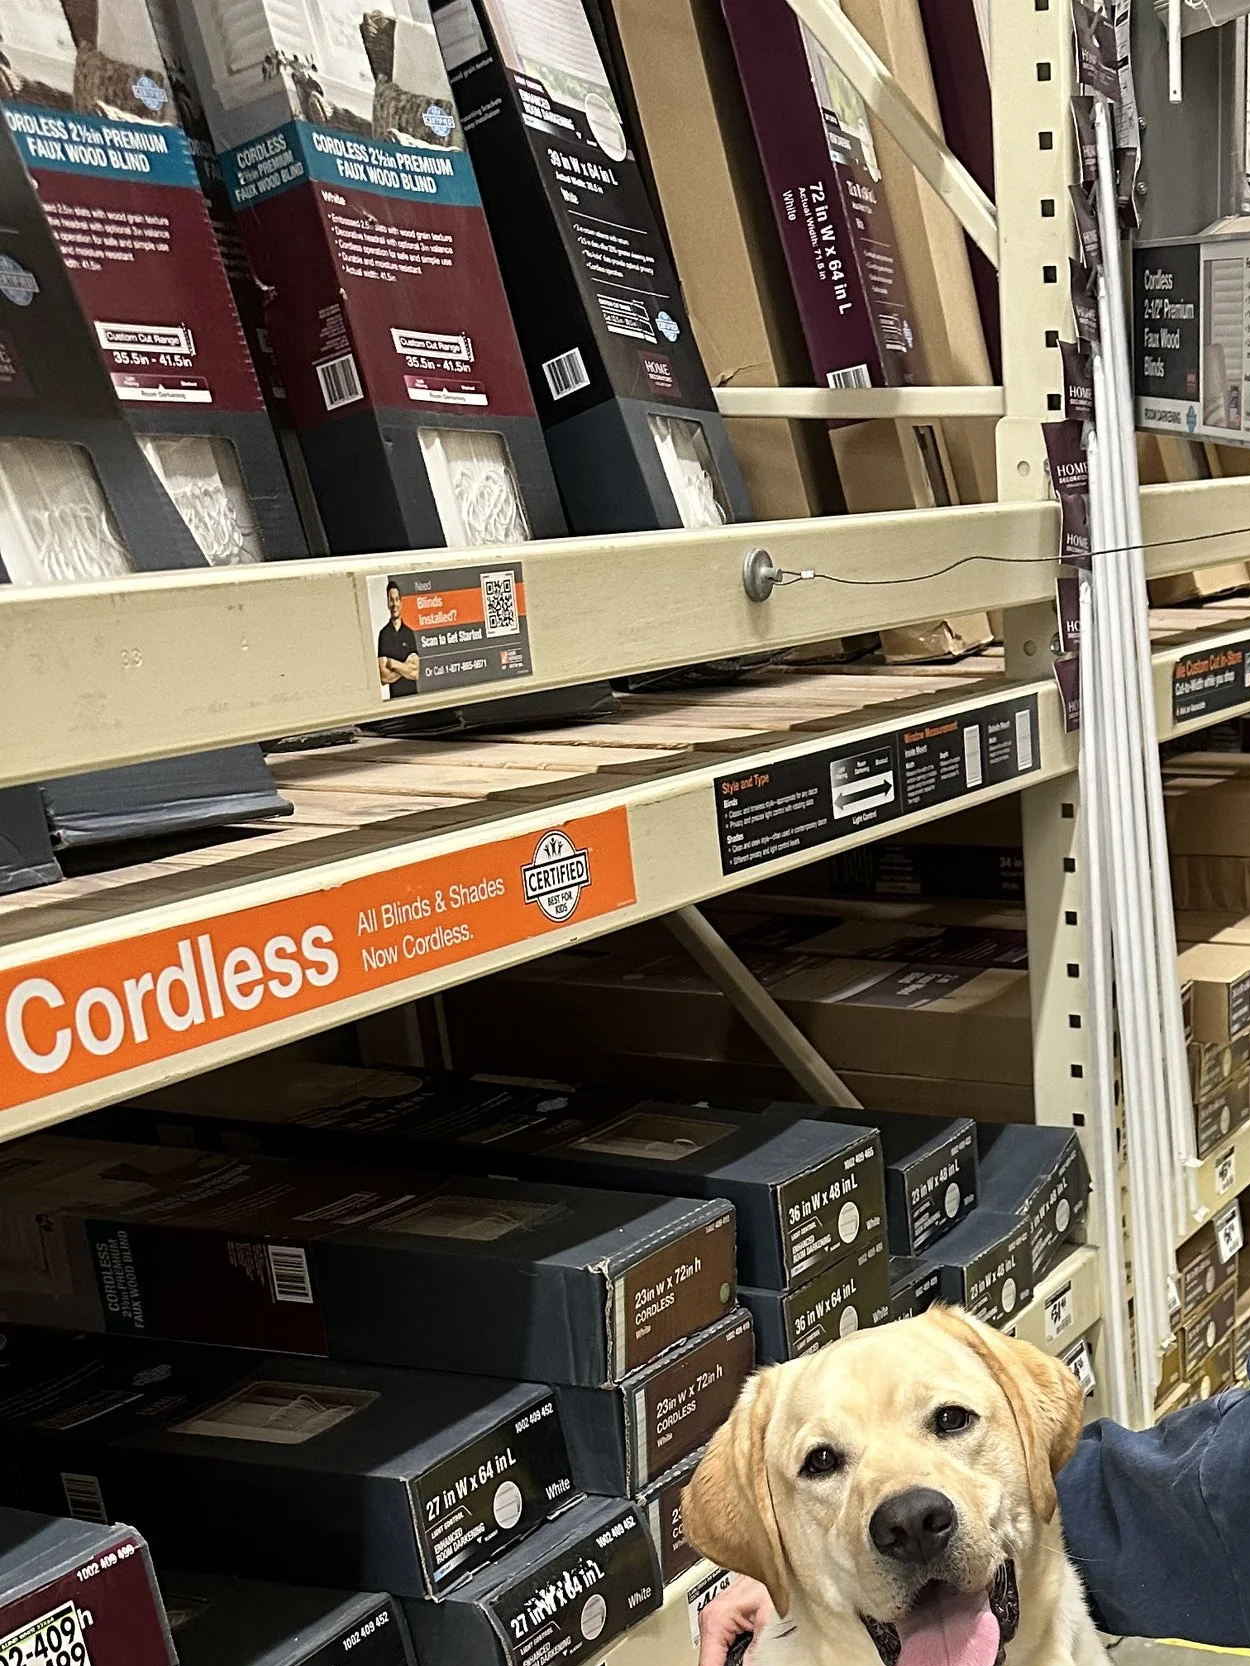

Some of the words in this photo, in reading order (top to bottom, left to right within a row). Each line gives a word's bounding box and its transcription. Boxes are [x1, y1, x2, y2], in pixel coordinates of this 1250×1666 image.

[6, 112, 68, 139] ORDLESS
[104, 128, 168, 153] PREMIUM
[27, 139, 63, 160] FAUX
[67, 145, 108, 167] WOOD
[110, 151, 150, 172] BLIND
[312, 132, 368, 161] CORDLESS
[396, 152, 454, 176] PREMIUM
[337, 159, 364, 181] FAUX
[367, 168, 400, 188] WOOD
[402, 174, 437, 193] BLIND
[322, 190, 346, 206] White
[810, 181, 825, 203] 72
[783, 190, 796, 221] White
[815, 205, 828, 222] in
[820, 225, 835, 241] W
[825, 246, 836, 256] x
[828, 260, 844, 281] 64
[1144, 269, 1173, 290] Cordless
[834, 284, 847, 299] in
[839, 303, 852, 314] L
[1163, 300, 1195, 320] Premium
[1144, 328, 1160, 348] Faux
[1161, 328, 1180, 349] Wood
[406, 356, 435, 369] 35.5in
[443, 361, 471, 372] 41.5in
[1144, 356, 1165, 377] Blinds
[415, 581, 431, 591] Need
[417, 597, 443, 609] Blinds
[419, 610, 457, 625] Installed?
[421, 637, 437, 648] Scan
[439, 635, 445, 644] to
[447, 632, 458, 643] Get
[459, 628, 482, 642] Started
[1187, 659, 1209, 676] Custom
[722, 781, 739, 795] Style
[740, 777, 753, 789] and
[754, 774, 769, 787] Type
[528, 860, 585, 892] CERTIFIED
[358, 911, 377, 936] All
[381, 898, 431, 928] Blinds
[434, 890, 447, 912] &
[450, 877, 505, 908] Shades
[547, 893, 560, 906] BEST
[561, 891, 572, 903] FOR
[555, 903, 568, 914] KIDS
[362, 944, 397, 972] Now
[403, 924, 474, 959] Cordless.
[4, 923, 340, 1075] Cordless
[635, 1288, 654, 1309] 23in
[675, 1264, 694, 1284] 72in
[694, 1257, 701, 1273] h
[636, 1293, 675, 1325] CORDLESS
[635, 1324, 651, 1339] White
[426, 1498, 441, 1521] 27
[443, 1490, 455, 1509] in
[456, 1478, 469, 1500] W
[469, 1476, 477, 1490] x
[479, 1462, 494, 1485] 64
[496, 1455, 507, 1475] in
[507, 1448, 516, 1467] L
[545, 1478, 570, 1501] White
[77, 1563, 100, 1582] 1002
[100, 1553, 117, 1569] 409
[118, 1544, 134, 1559] 499
